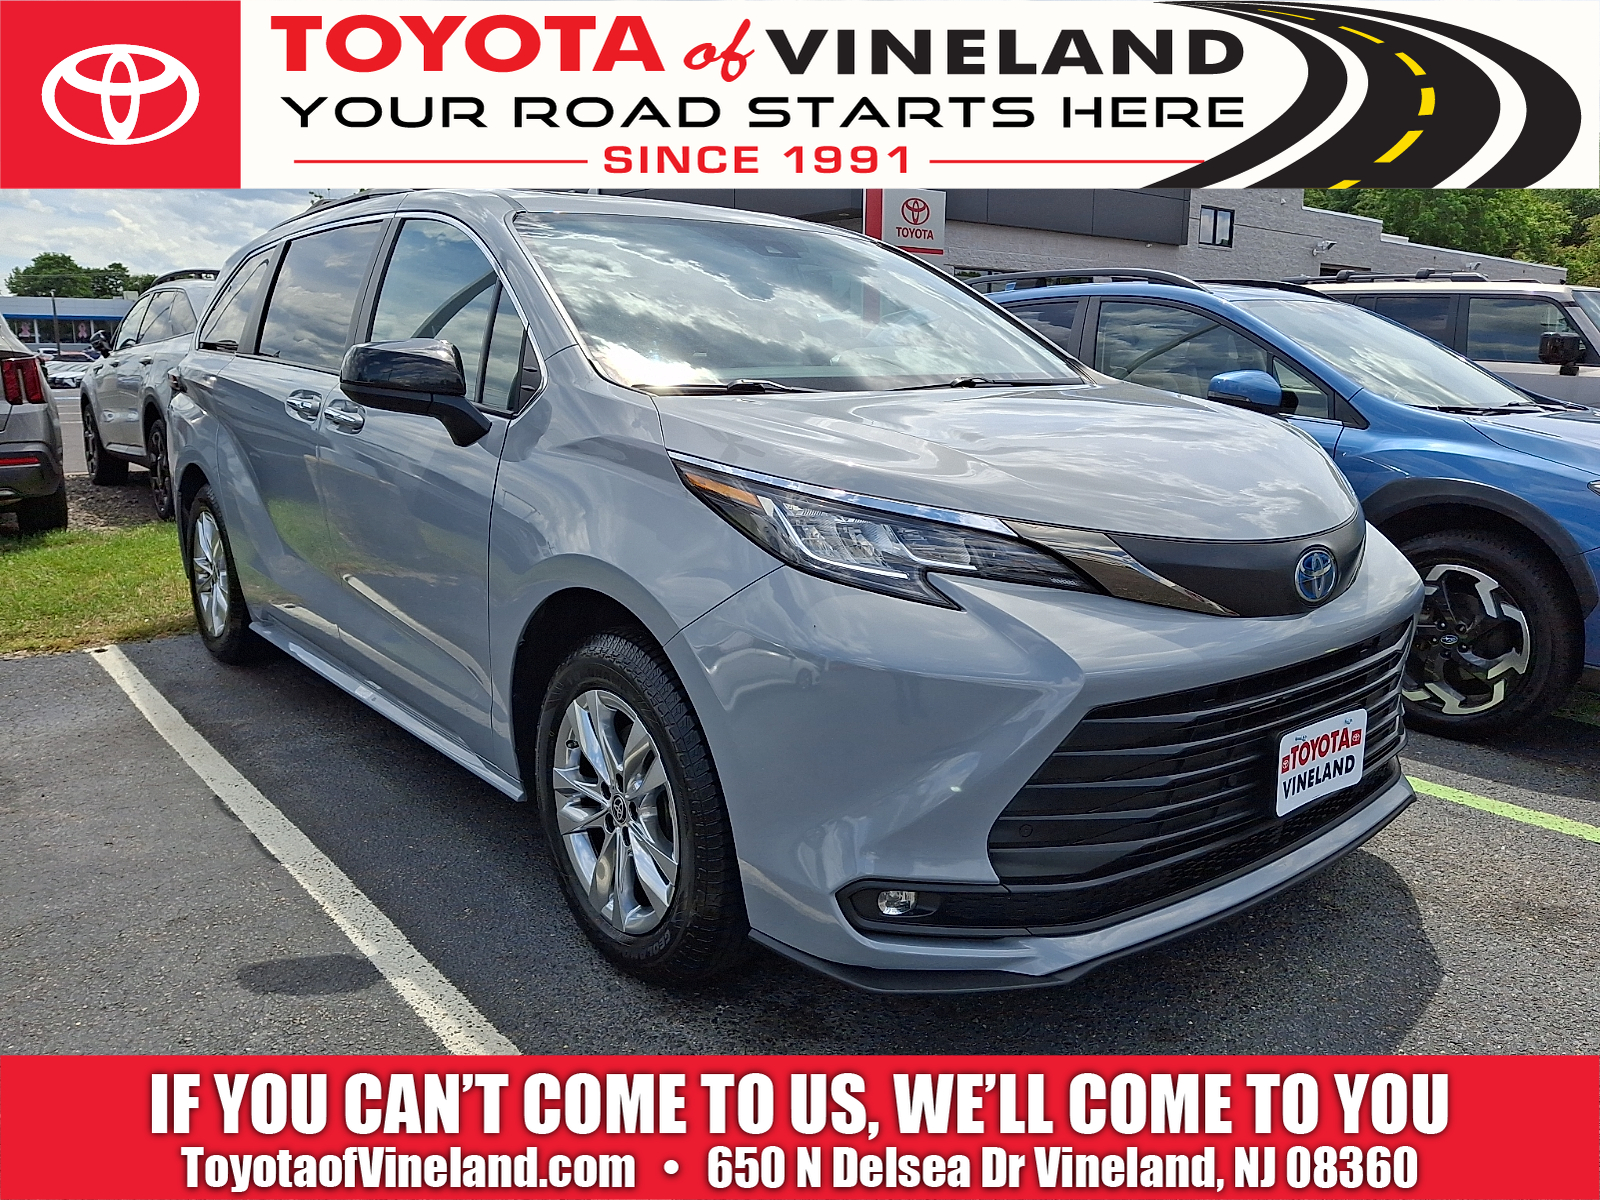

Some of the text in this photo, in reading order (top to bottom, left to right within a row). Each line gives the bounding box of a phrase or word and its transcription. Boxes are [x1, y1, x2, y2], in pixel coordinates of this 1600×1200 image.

[896, 227, 934, 240] TOYOTA
[1291, 727, 1350, 770] TOYOTA
[1283, 755, 1356, 799] VINELAND
